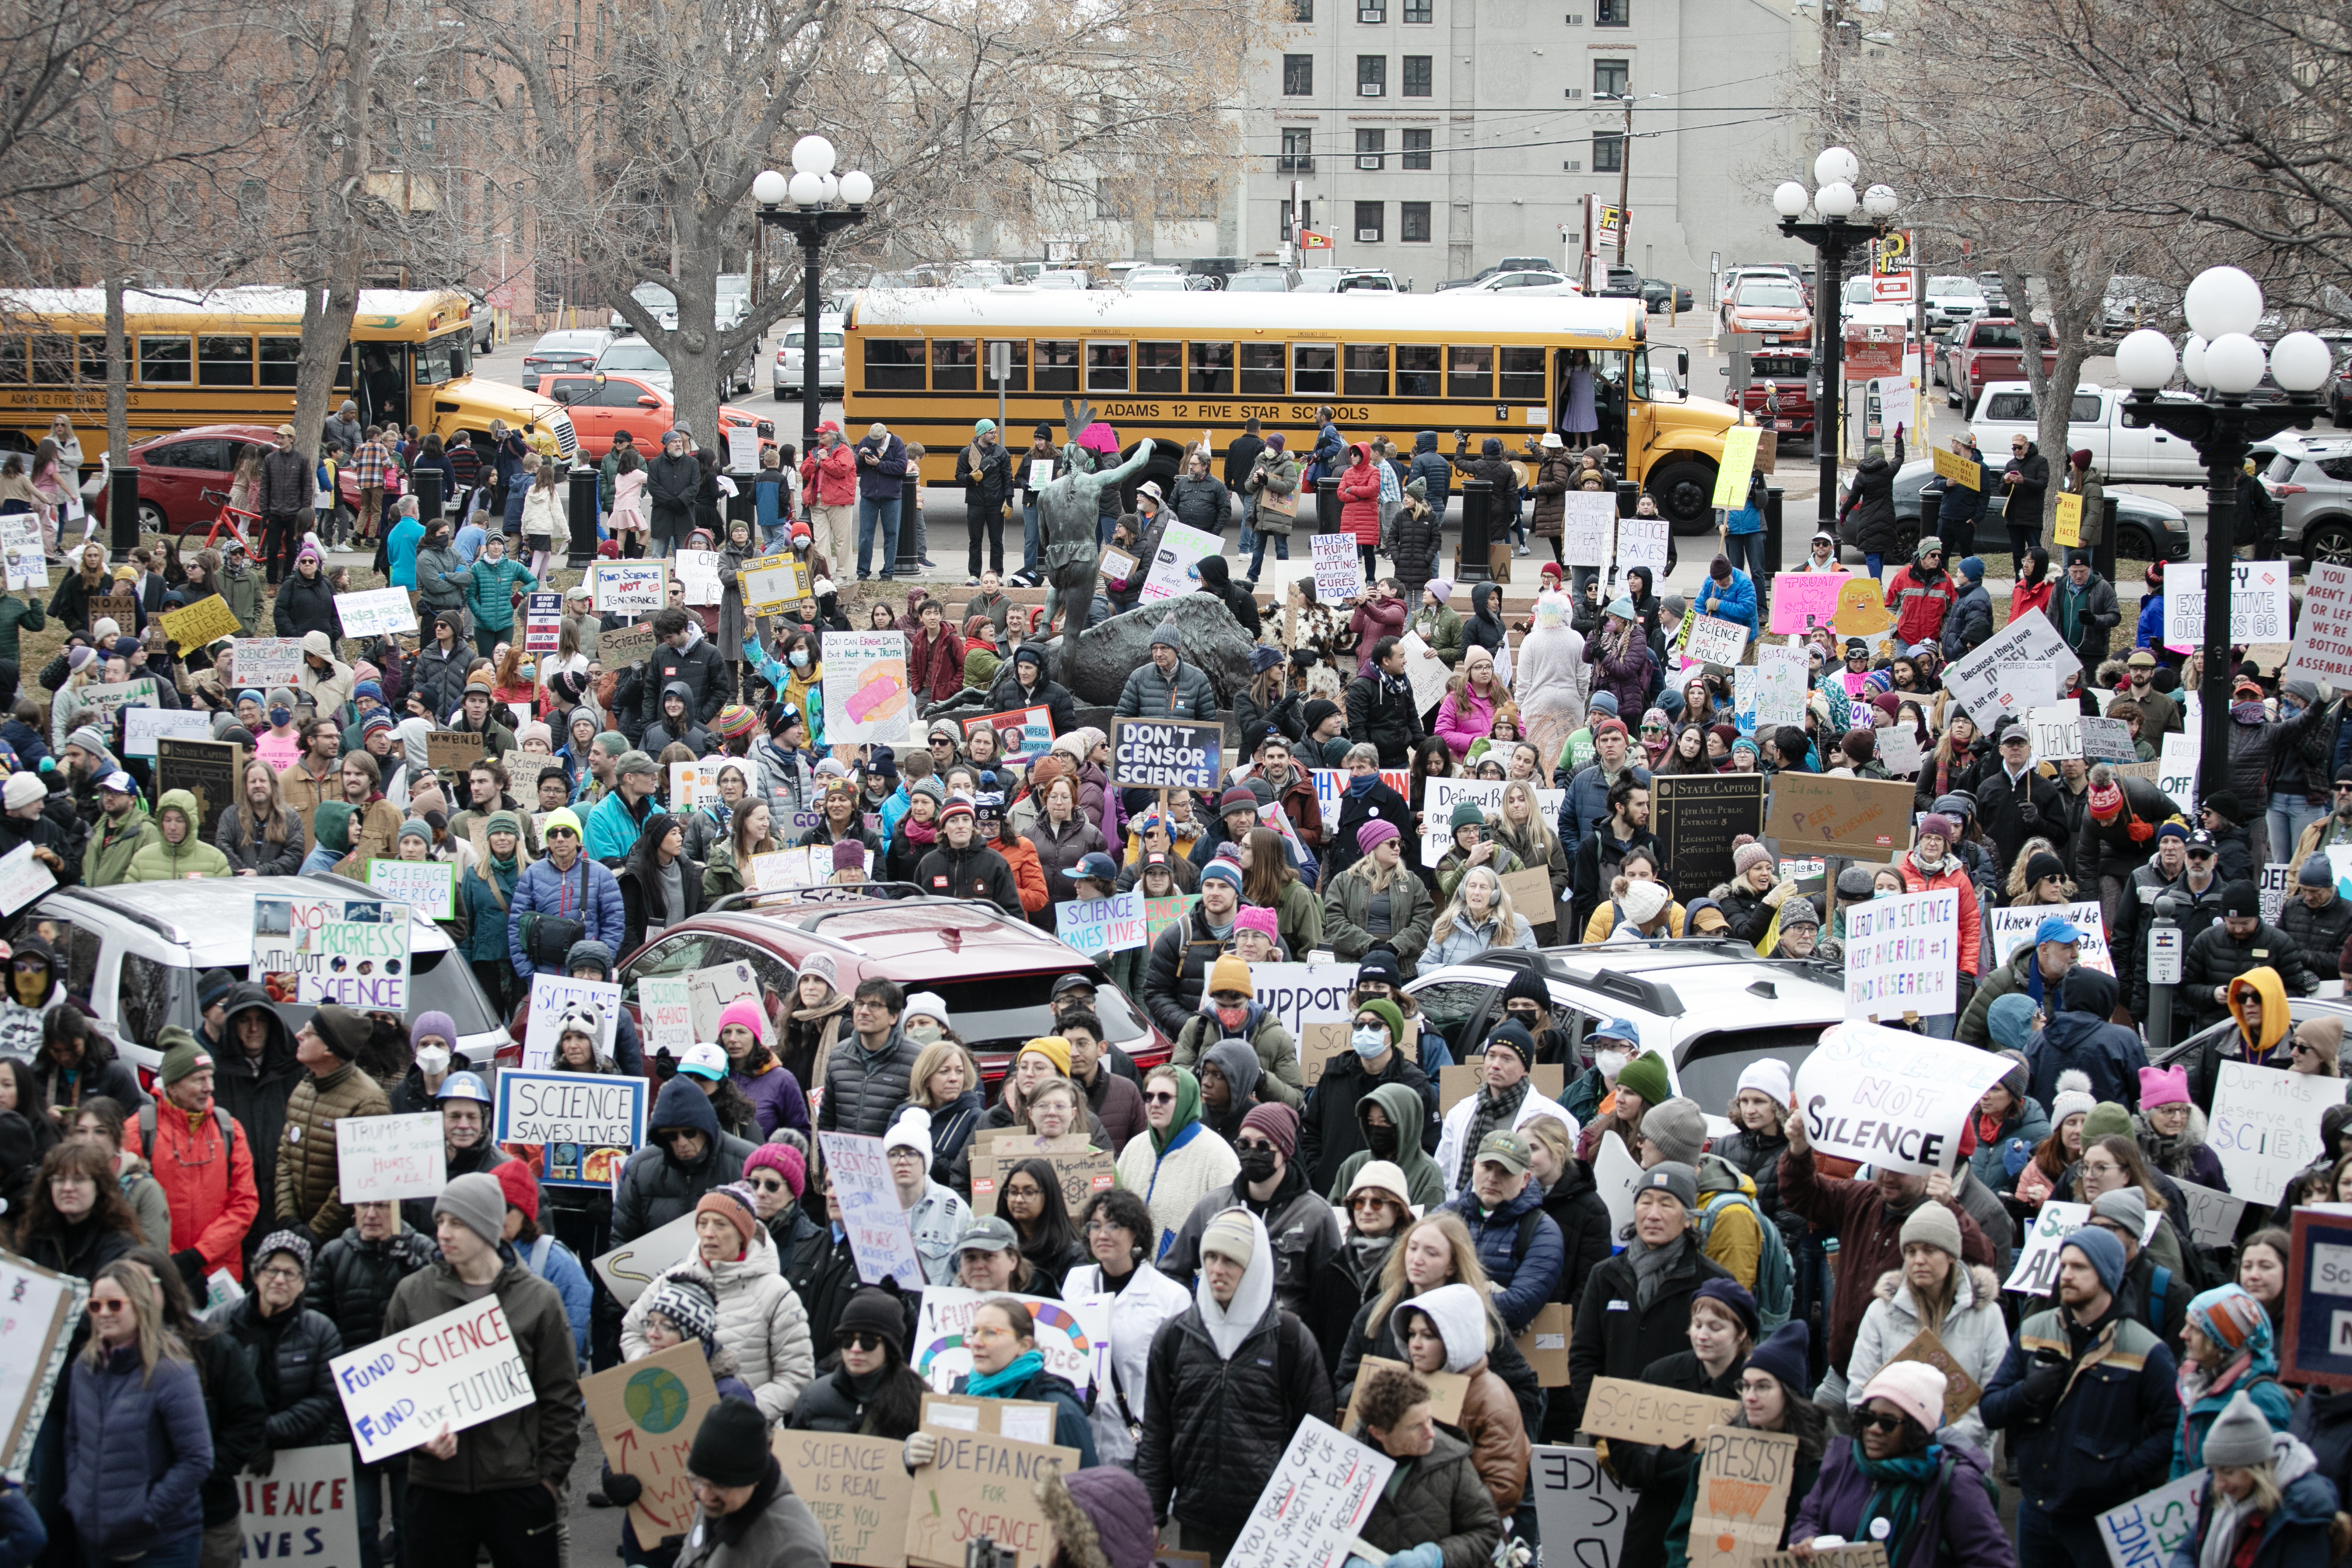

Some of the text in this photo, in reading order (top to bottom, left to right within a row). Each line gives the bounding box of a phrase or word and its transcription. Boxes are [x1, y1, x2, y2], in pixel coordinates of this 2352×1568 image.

[1311, 237, 1324, 247] PARK
[1870, 327, 1889, 340] PARK
[11, 394, 139, 405] ADAMS 12 FIVE STAR SOLS
[1883, 383, 1910, 396] Support
[1104, 404, 1279, 419] ADAMS 12 FIVE STAR
[1939, 450, 1974, 469] Burn GAS
[1568, 495, 1606, 510] MAKE
[1619, 520, 1667, 540] SCIENCE
[2060, 518, 2076, 526] against
[2060, 527, 2076, 537] FACTS
[1160, 552, 1172, 561] NIH
[1315, 543, 1353, 555] TRUMP
[1618, 544, 1666, 560] SAVES
[9, 564, 43, 576] SCIENCE
[1315, 560, 1357, 570] CUTTING
[598, 570, 659, 583] FUND SCIENCE
[798, 571, 808, 589] NOCA
[1785, 576, 1839, 588] TRUMP
[2322, 569, 2345, 584] YOU
[619, 581, 642, 593] NOT
[1318, 586, 1359, 598] TODAY
[2307, 585, 2344, 602] AREN'T
[605, 595, 659, 607] IGNORANCE
[2311, 602, 2327, 615] OR
[166, 599, 219, 630] SCIENCE
[1699, 615, 1742, 632] DEFUNDING
[2254, 614, 2278, 635] 66
[172, 612, 231, 642] MATTERS
[352, 617, 381, 633] SAVE
[1699, 623, 1739, 642] SCIENCE
[825, 636, 841, 646] YOU
[882, 637, 902, 646] DATA
[238, 647, 299, 659] SCIENCE LIVES
[827, 648, 902, 658] But Not the TRUTH
[1694, 647, 1730, 665] POLICY
[263, 661, 296, 673] gangsters
[1415, 664, 1444, 700] ARGUMENT
[172, 716, 208, 727] SCIENCE
[2090, 718, 2117, 729] FUND
[1123, 723, 1193, 747] DON'T
[2083, 727, 2130, 740] SCIENCE
[1118, 743, 1205, 767] CENSOR
[1118, 765, 1210, 788] SCIENCE
[2160, 776, 2191, 794] OFF
[1439, 785, 1488, 808] Defund
[1678, 781, 1757, 793] STATE CAPITOL
[1792, 804, 1836, 833] PEER
[1820, 803, 1884, 841] REVIEWING
[754, 853, 808, 876] Public Health
[291, 904, 323, 930] NO
[1067, 896, 1134, 925] SCIENCE
[1528, 908, 1547, 920] Great
[1876, 906, 1897, 931] WITH
[1902, 897, 1951, 928] SCIENCE
[1995, 912, 2002, 930] I
[2005, 911, 2032, 930] knew
[2084, 908, 2098, 924] be
[320, 923, 404, 959] PROGRESS
[1062, 917, 1148, 949] SAVES LIVES
[252, 949, 324, 977] WITHOUT
[1851, 937, 1947, 971] KEEP AMERICA #1
[310, 978, 403, 1008] SCIENCE
[1851, 970, 1943, 1004] FUND RESEARCH
[656, 1007, 688, 1025] AGAINST
[2222, 1064, 2311, 1102] Our kids
[518, 1083, 631, 1120] SCIENCE
[1853, 1075, 1947, 1120] NOT
[2214, 1092, 2303, 1129] deserve a
[513, 1124, 630, 1144] SAVES LIVES
[1808, 1094, 1945, 1167] SILENCE
[824, 1134, 875, 1156] THANK A
[373, 1156, 415, 1174] HURTS
[830, 1151, 884, 1177] SCIENTIST
[357, 1176, 378, 1189] US
[840, 1170, 856, 1183] FOR
[2253, 1174, 2283, 1198] the
[340, 1305, 509, 1395] FUND SCIENCE
[355, 1354, 532, 1448] FUND the FUTURE
[1594, 1384, 1704, 1426] SCIENCE
[797, 1439, 885, 1471] SCIENCE
[1706, 1434, 1796, 1484] RESIST
[816, 1473, 887, 1502] IS REAL
[982, 1484, 1007, 1504] FOR
[1237, 1429, 1321, 1561] YOU REALLY CARE
[1274, 1441, 1336, 1540] SANCTITY OF
[1331, 1463, 1377, 1533] RESEARCH
[853, 1506, 879, 1526] YOU
[952, 1507, 1039, 1552] SCIENCE
